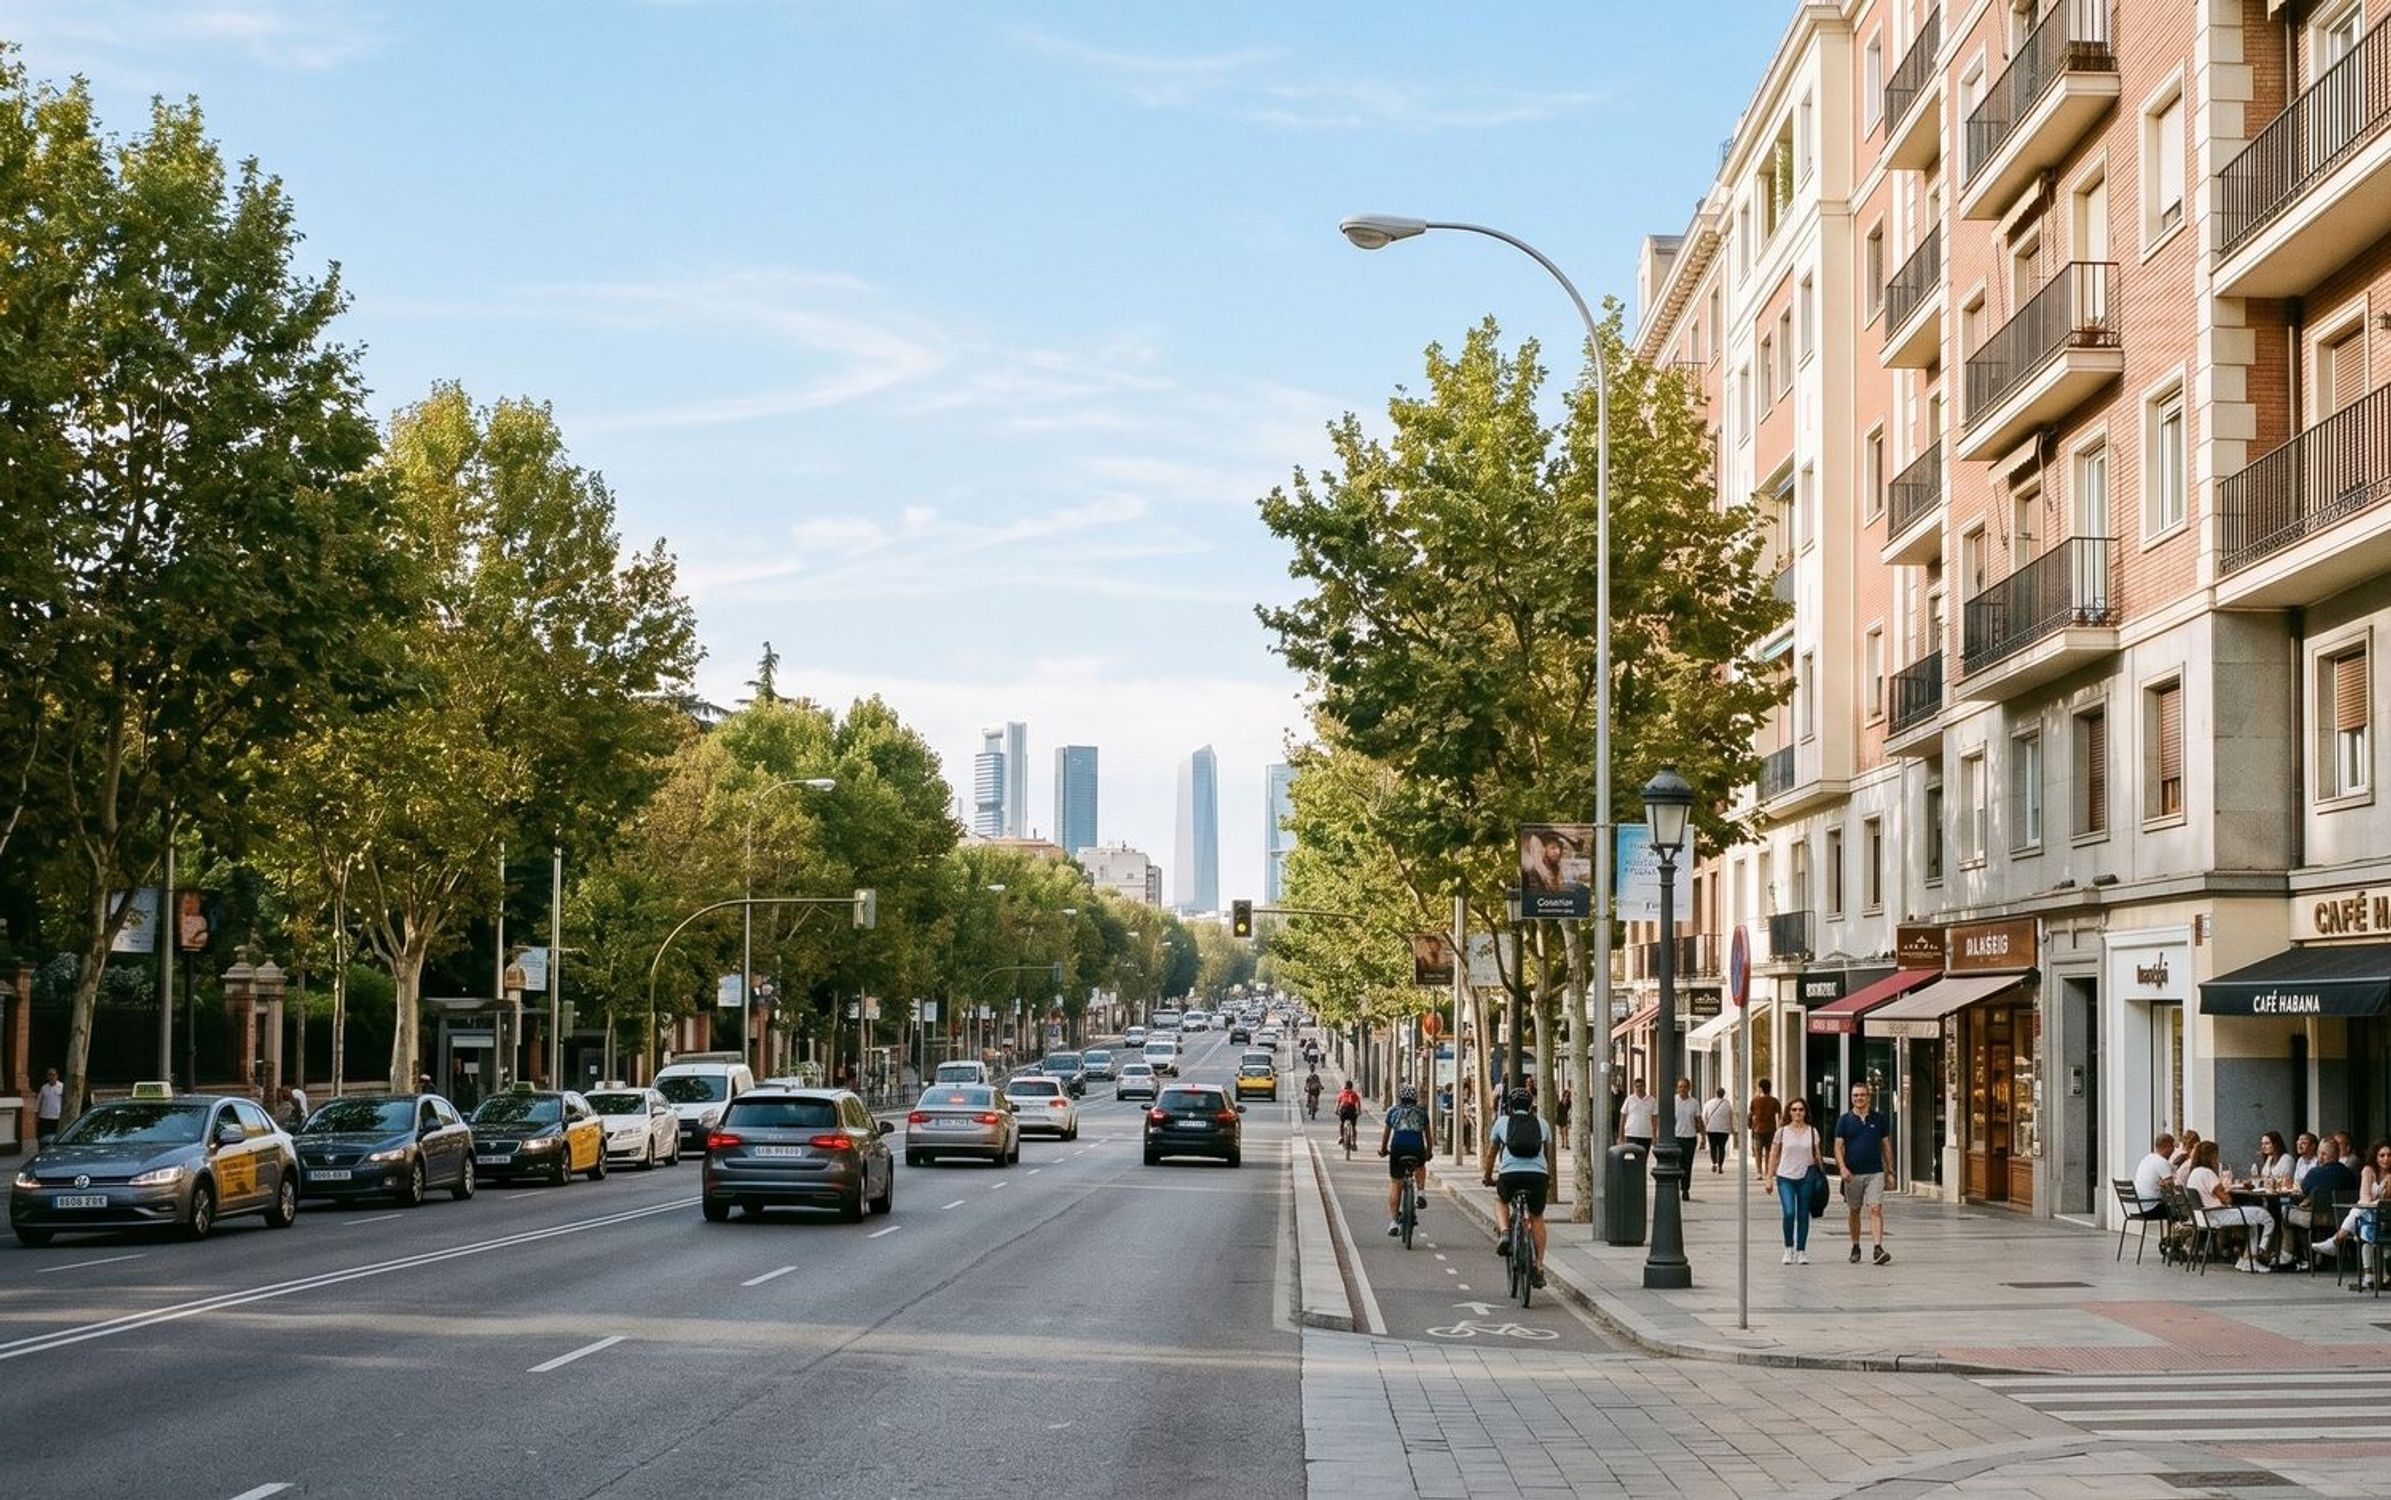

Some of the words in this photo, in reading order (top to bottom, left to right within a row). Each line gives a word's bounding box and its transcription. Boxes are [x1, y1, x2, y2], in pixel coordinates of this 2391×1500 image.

[2314, 891, 2368, 935] CAFÉ
[2373, 896, 2391, 931] H
[2253, 989, 2277, 1013] CAFÉ
[2279, 994, 2320, 1013] HABANA
